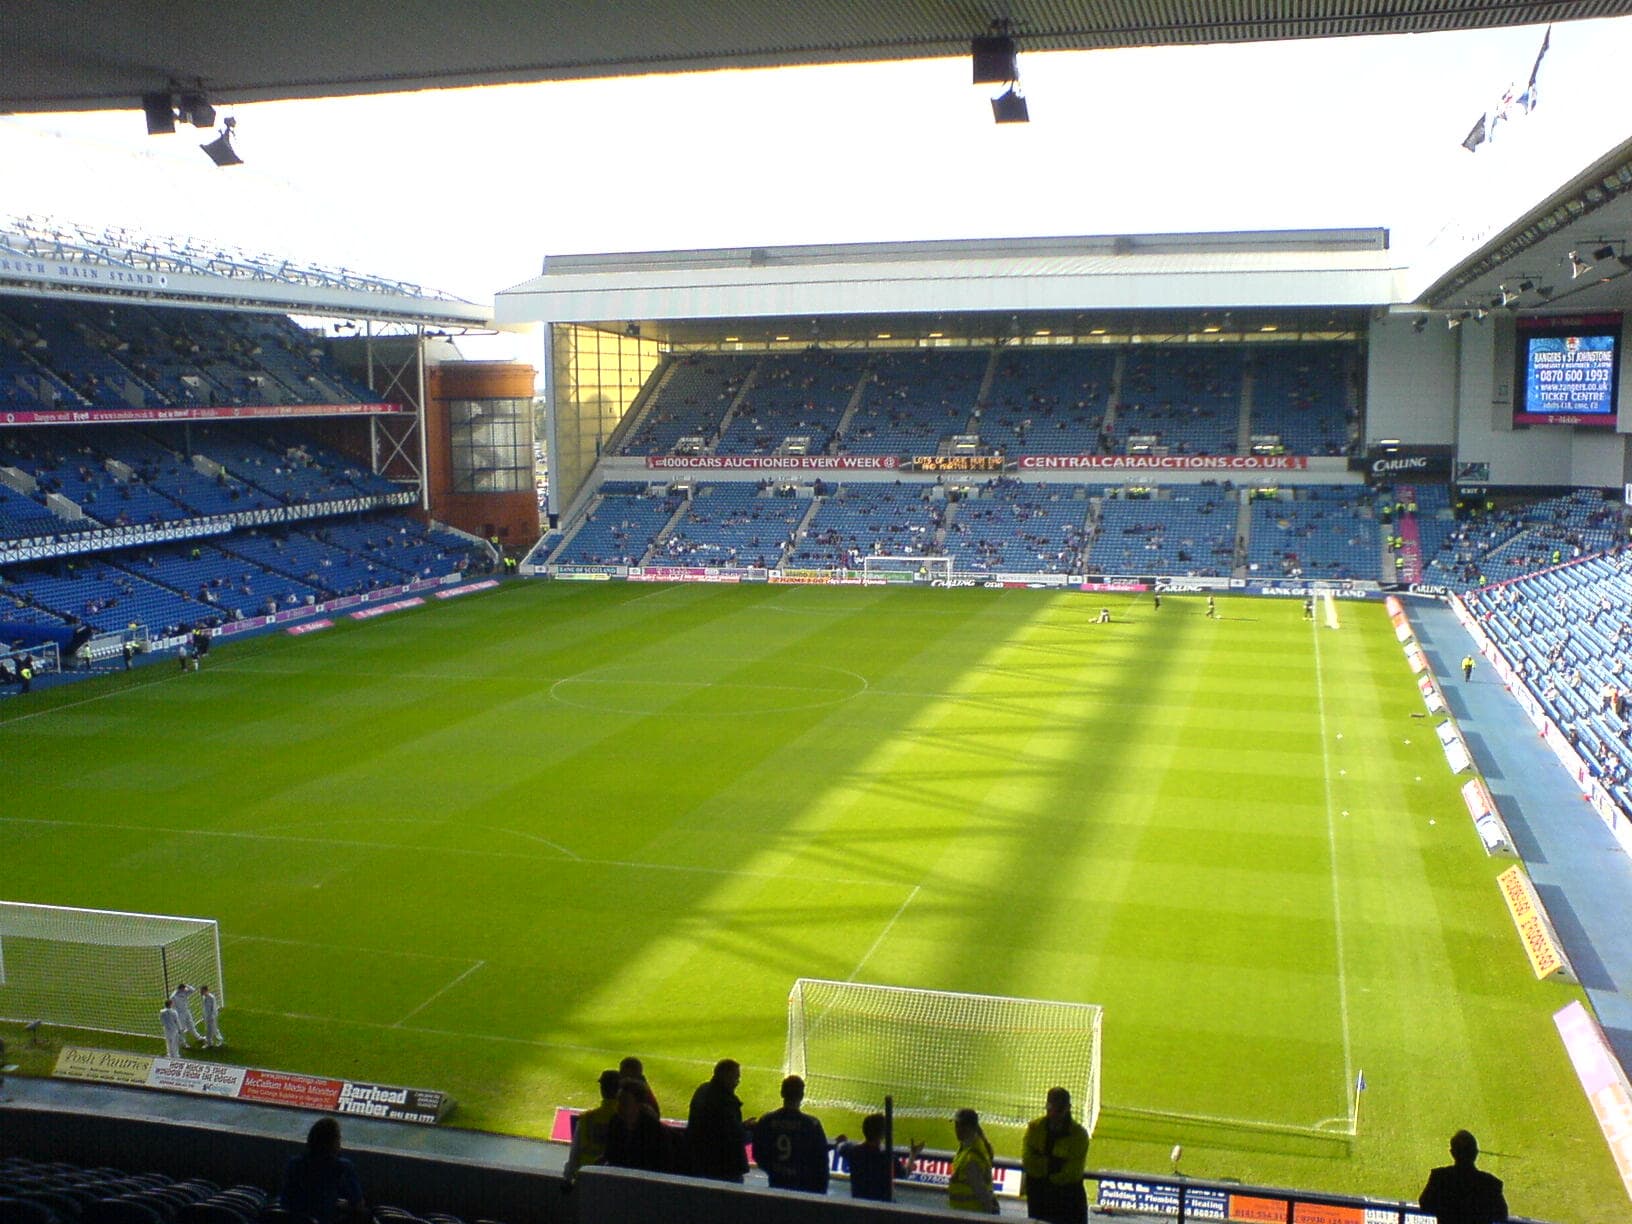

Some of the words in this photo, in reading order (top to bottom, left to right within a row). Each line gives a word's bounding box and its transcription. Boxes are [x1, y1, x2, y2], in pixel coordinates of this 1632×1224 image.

[59, 266, 98, 278] MAIN
[109, 271, 153, 284] STAND
[1540, 371, 1563, 381] 0870
[1565, 370, 1583, 381] 600
[1586, 370, 1608, 380] 1993
[1541, 382, 1607, 392] www.rangers.co.uk
[1541, 392, 1568, 400] TICKET
[1571, 392, 1605, 400] CENTRE
[690, 458, 721, 467] CARS
[724, 457, 799, 468] AUCTIONED
[802, 457, 841, 468] EVERY
[843, 457, 881, 468] WEEK
[1023, 457, 1288, 468] CENTRALCARAUCTIONS.CO.UK
[1372, 457, 1427, 471] CARLING
[931, 579, 976, 588] CARLING
[1409, 584, 1446, 594] CARLING
[1262, 587, 1291, 595] BANK
[342, 1082, 408, 1104] Barrhead
[340, 1098, 389, 1118] Timber
[776, 1133, 792, 1160] 9
[1103, 1190, 1136, 1201] Building
[1192, 1199, 1224, 1210] Heating
